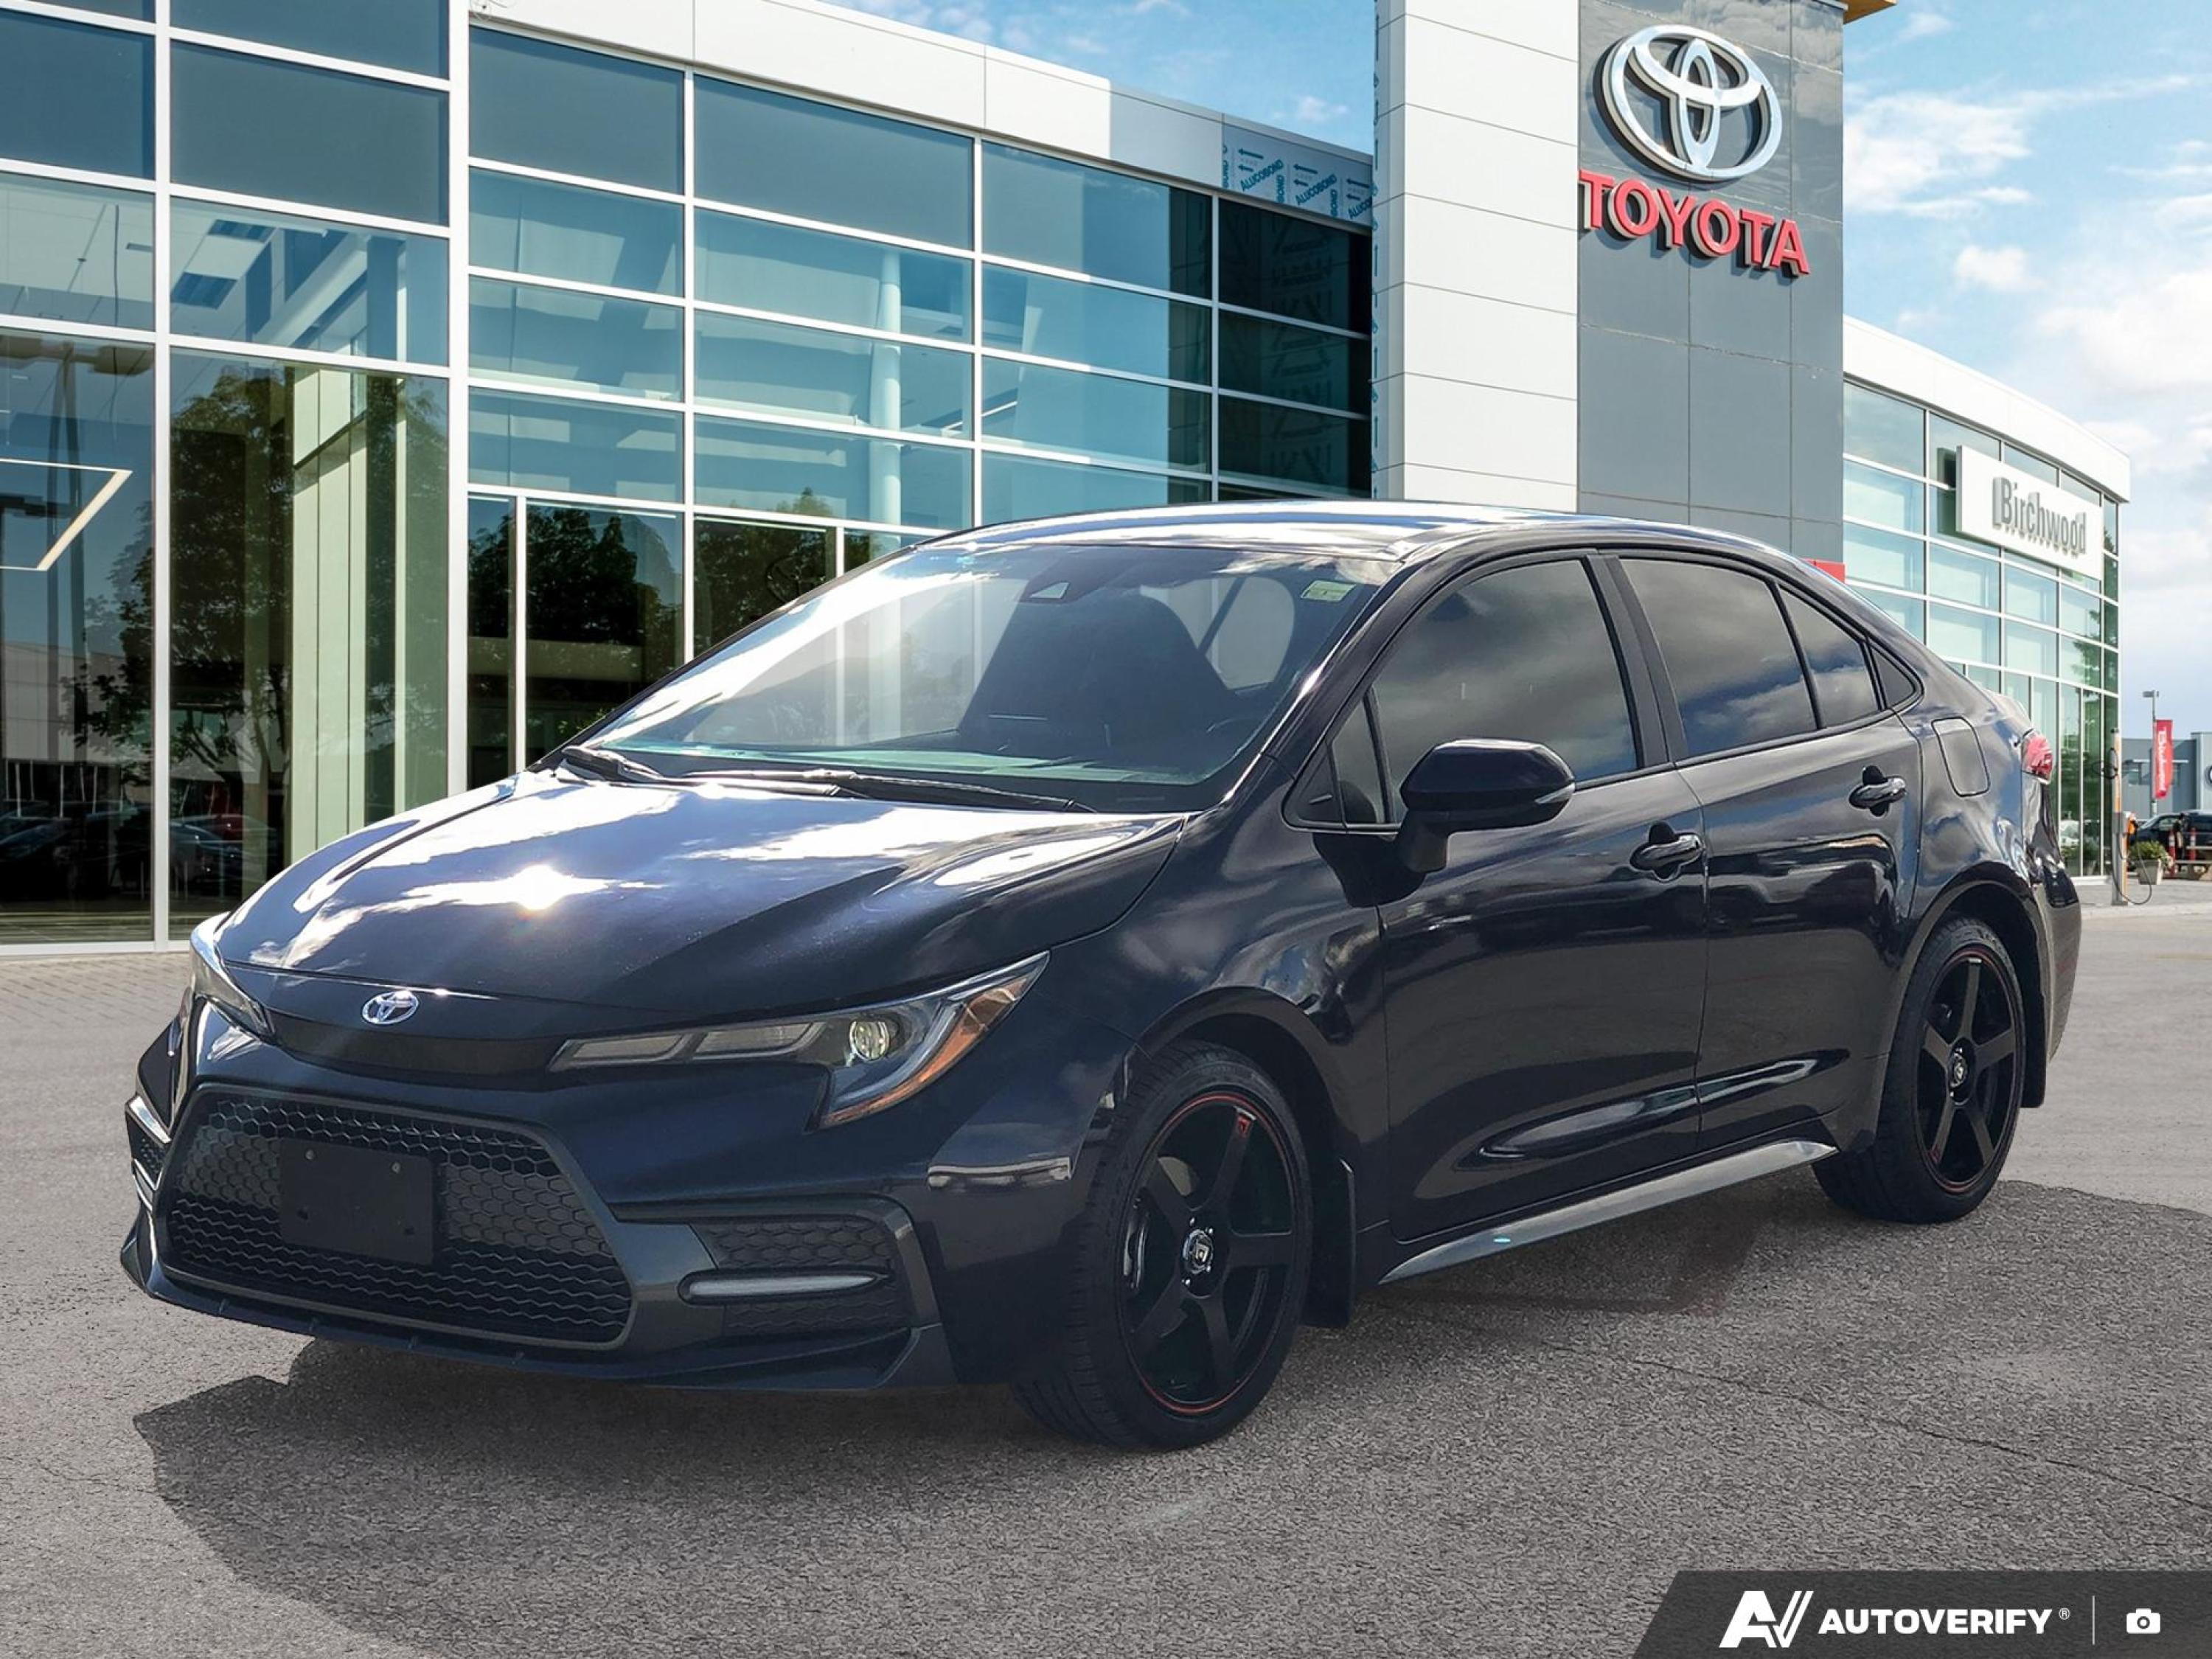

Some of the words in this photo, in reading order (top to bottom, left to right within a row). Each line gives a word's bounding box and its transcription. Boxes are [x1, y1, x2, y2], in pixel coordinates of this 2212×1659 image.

[1240, 159, 1284, 191] ALUCOBOND
[1295, 173, 1337, 206] ALUCOBOND
[1579, 169, 1809, 275] TOYOTA
[1998, 477, 2087, 555] Birchwood
